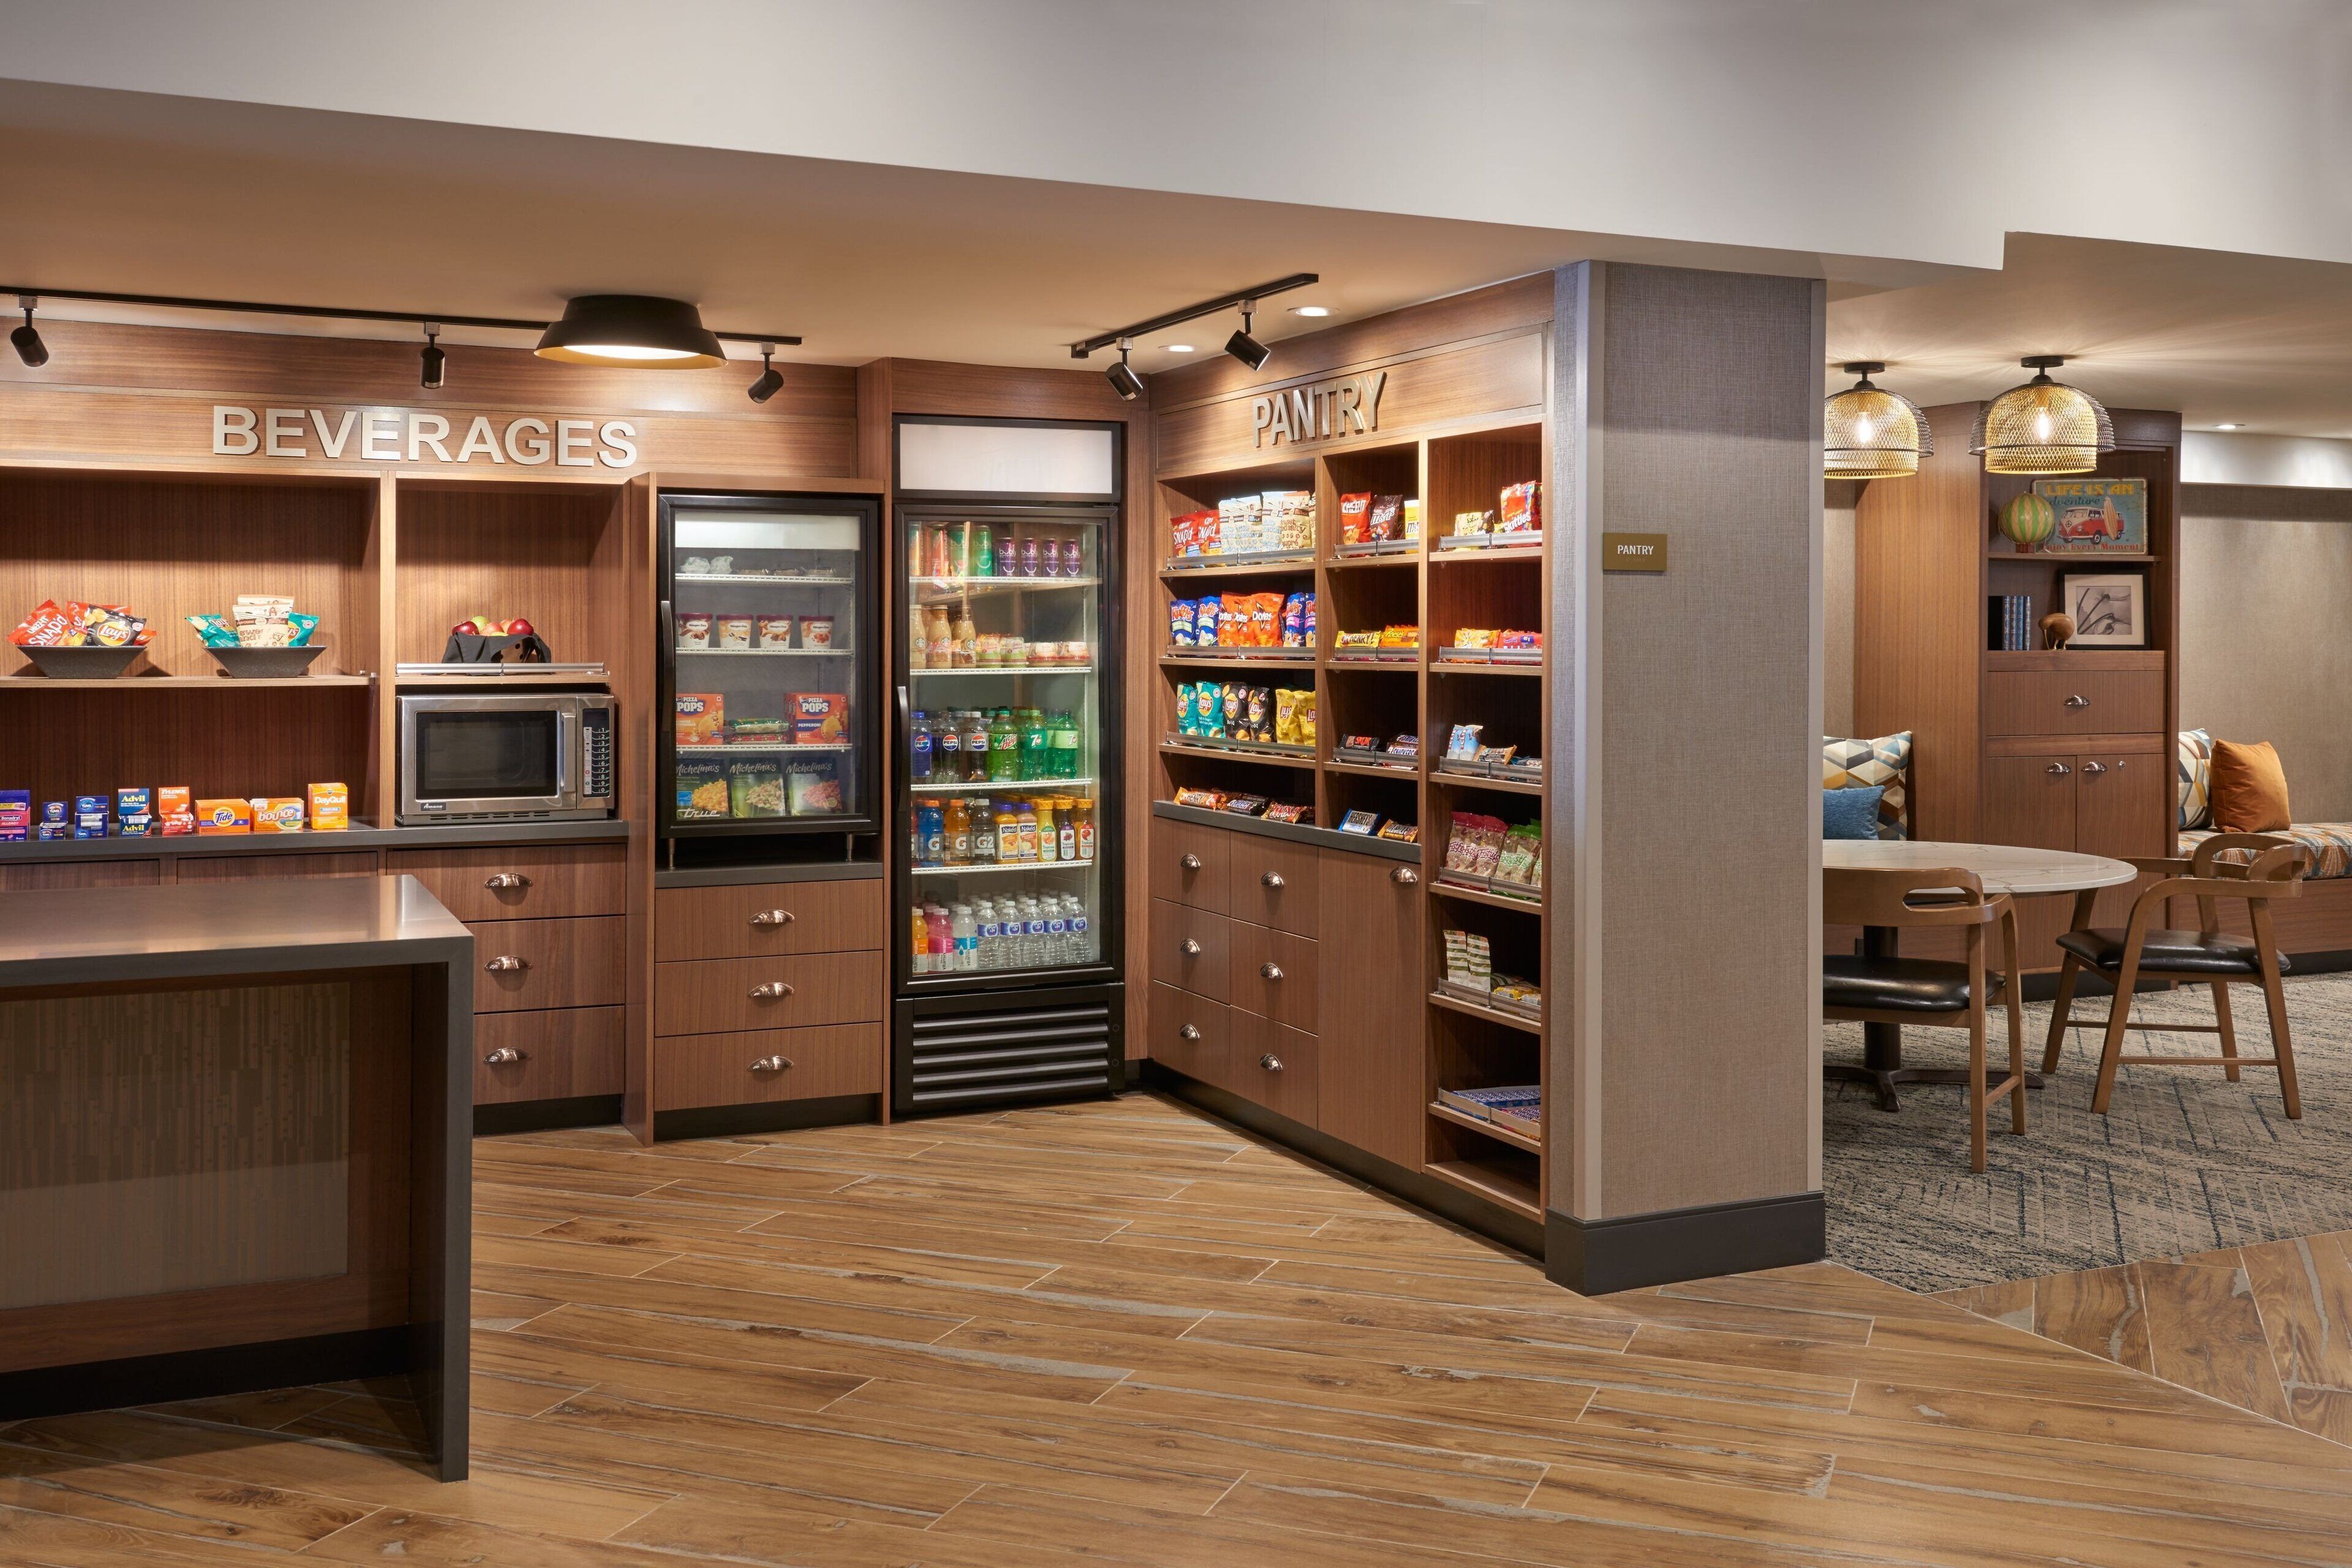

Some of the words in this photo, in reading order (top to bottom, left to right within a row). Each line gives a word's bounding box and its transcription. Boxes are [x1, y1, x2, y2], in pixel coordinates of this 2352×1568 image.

[1253, 371, 1387, 448] PANTRY
[213, 405, 638, 468] BEVERAGES
[2046, 483, 2082, 496] LIFE
[2086, 483, 2104, 496] IS
[2110, 483, 2134, 495] AN
[2048, 496, 2101, 506] dventure
[1504, 511, 1531, 533] Skittles
[1617, 545, 1654, 555] PANTRY
[1252, 611, 1272, 621] Doritos
[677, 702, 704, 712] POPS
[802, 703, 829, 712] POPS
[1355, 736, 1371, 745] SKOR
[729, 763, 777, 775] Michelina's
[786, 762, 832, 774] Michelina's
[314, 796, 346, 805] DayQuil
[215, 812, 233, 823] Tide
[258, 809, 295, 821] bounce
[678, 809, 720, 818] true
[928, 837, 940, 851] G
[956, 837, 967, 850] G
[977, 836, 994, 848] G2
